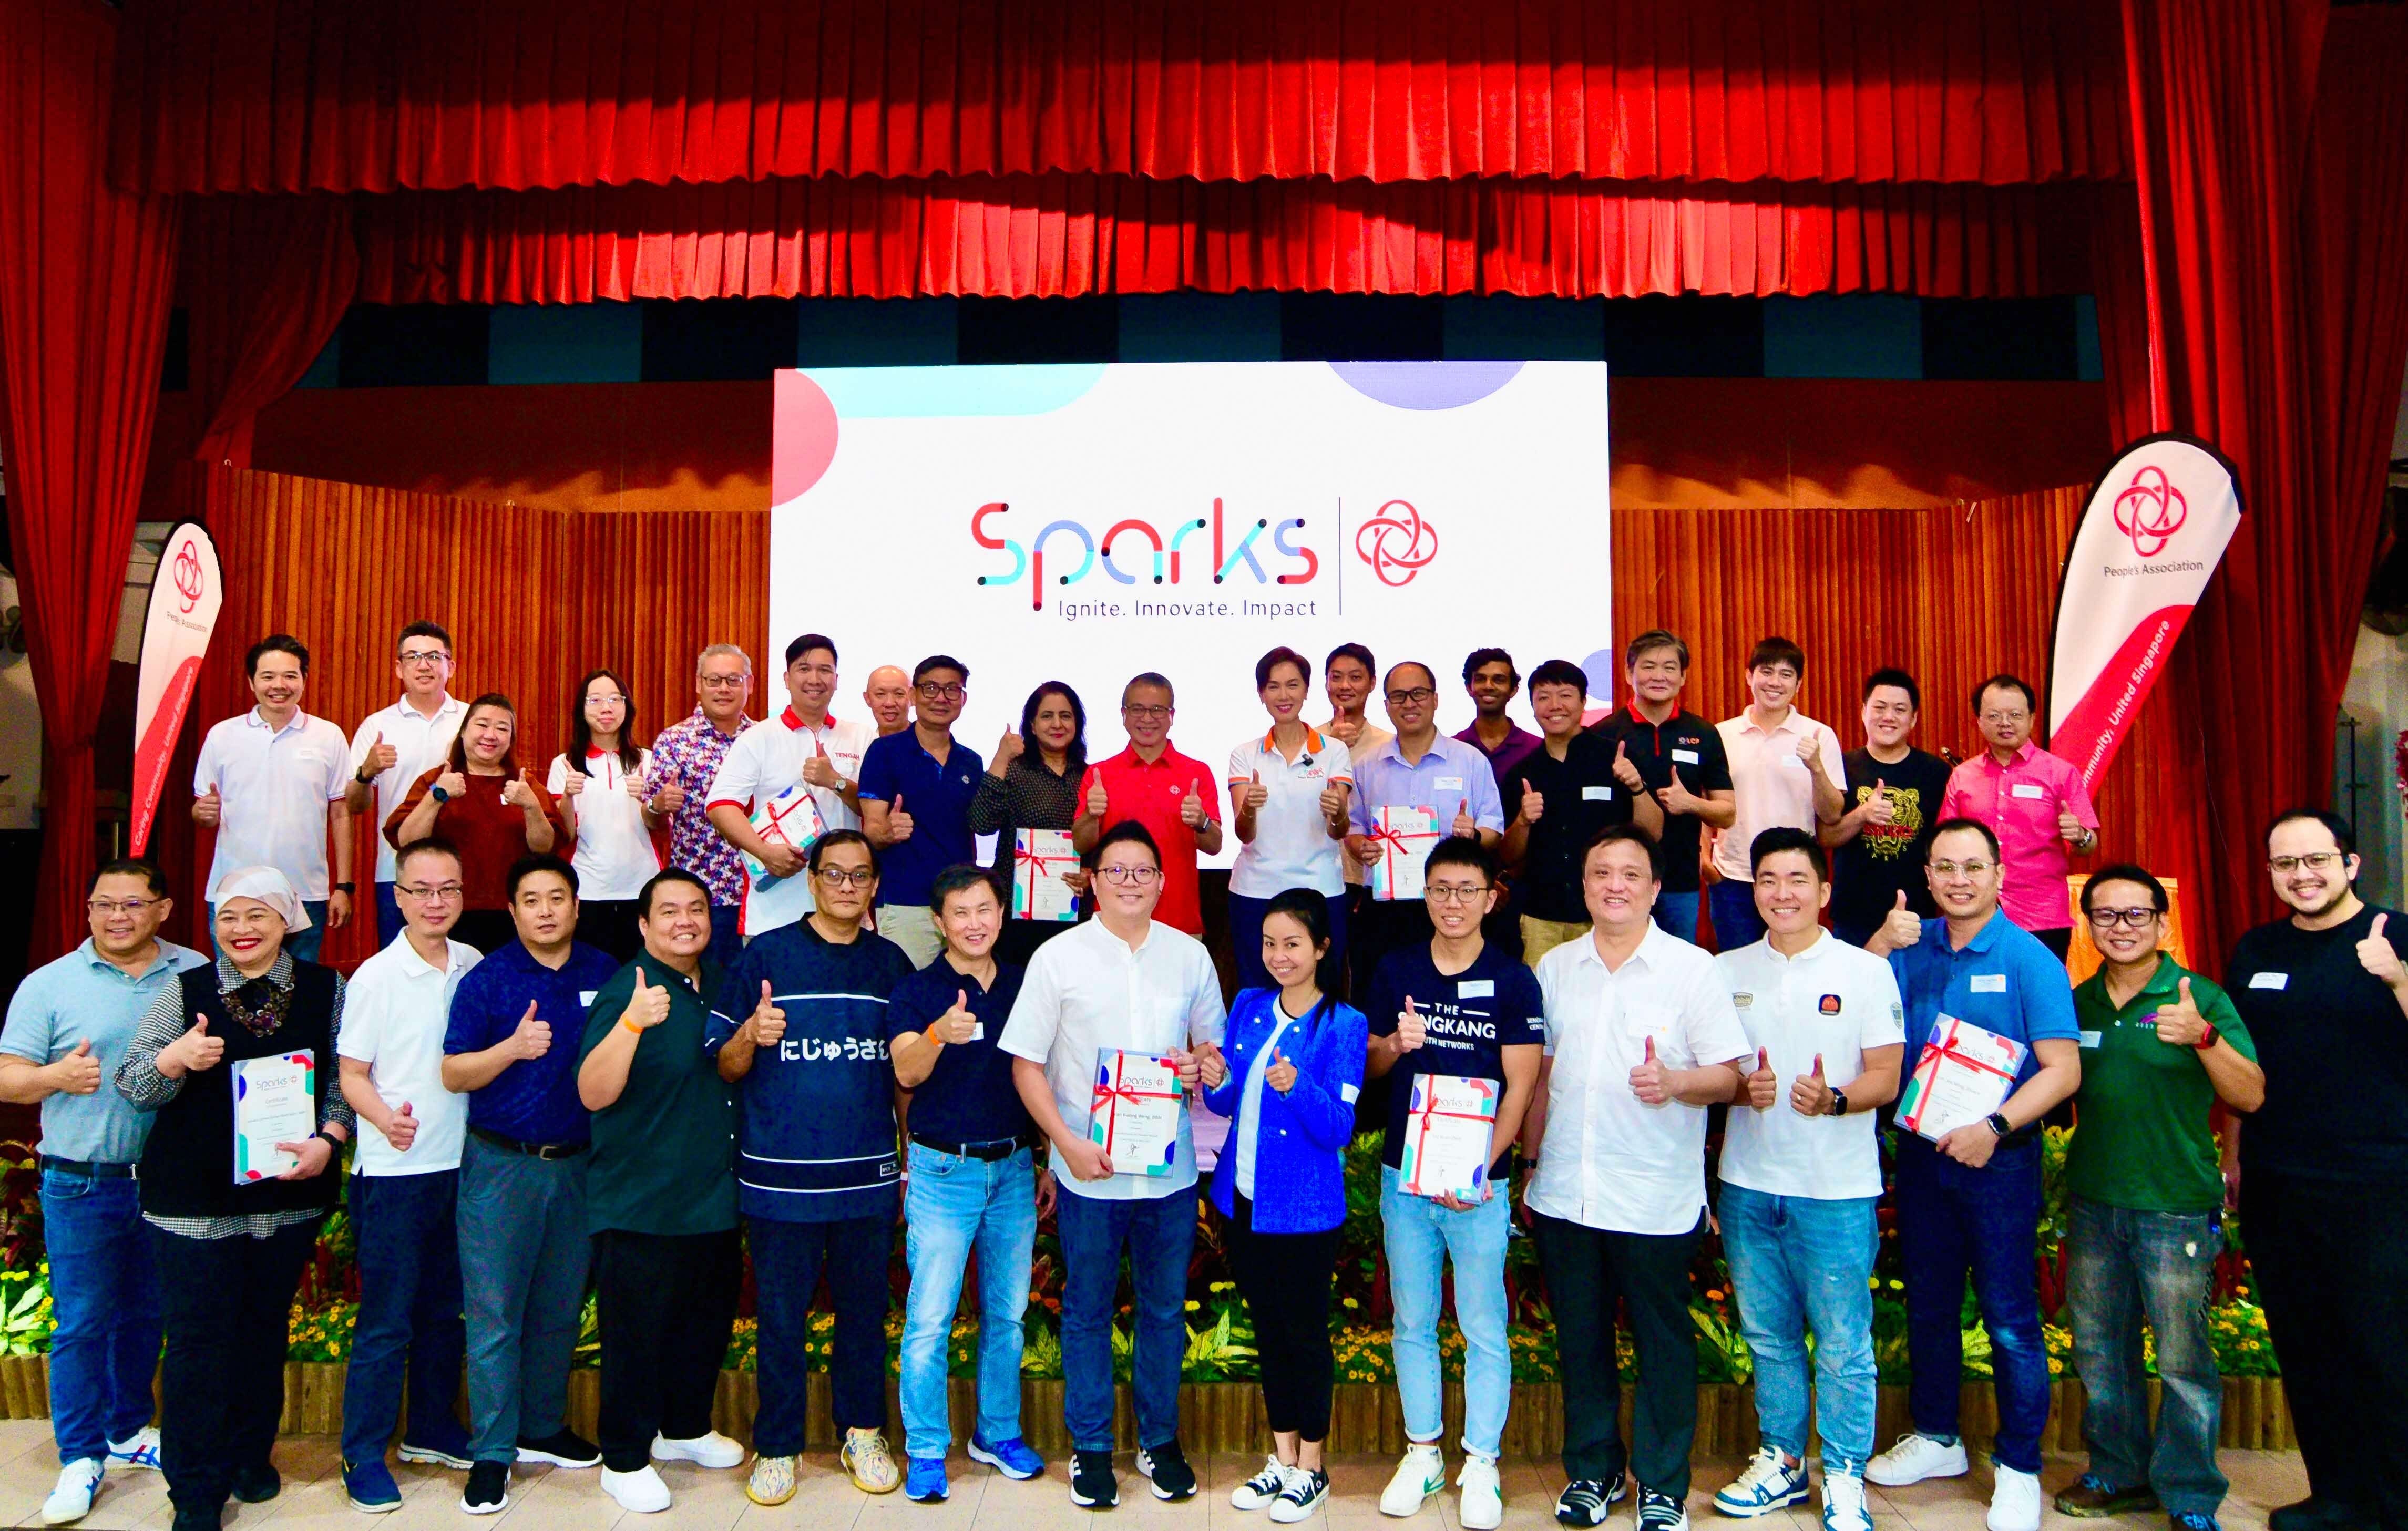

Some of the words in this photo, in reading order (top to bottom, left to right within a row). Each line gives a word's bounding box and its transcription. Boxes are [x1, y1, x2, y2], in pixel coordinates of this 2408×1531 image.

[971, 497, 1318, 611] Sparks
[2103, 564, 2139, 578] People's
[2142, 560, 2204, 576] Association
[1059, 600, 1126, 621] Ignite.
[1135, 600, 1234, 617] Innovate.
[1243, 600, 1317, 621] Impact
[2082, 729, 2114, 789] mmunity,
[2108, 682, 2136, 726] United
[2131, 619, 2170, 685] Singapore
[1435, 1002, 1459, 1015] THE
[1398, 1011, 1496, 1040] NGKANG
[1438, 1039, 1474, 1051] NETWORKS
[256, 1076, 288, 1091] Sparks
